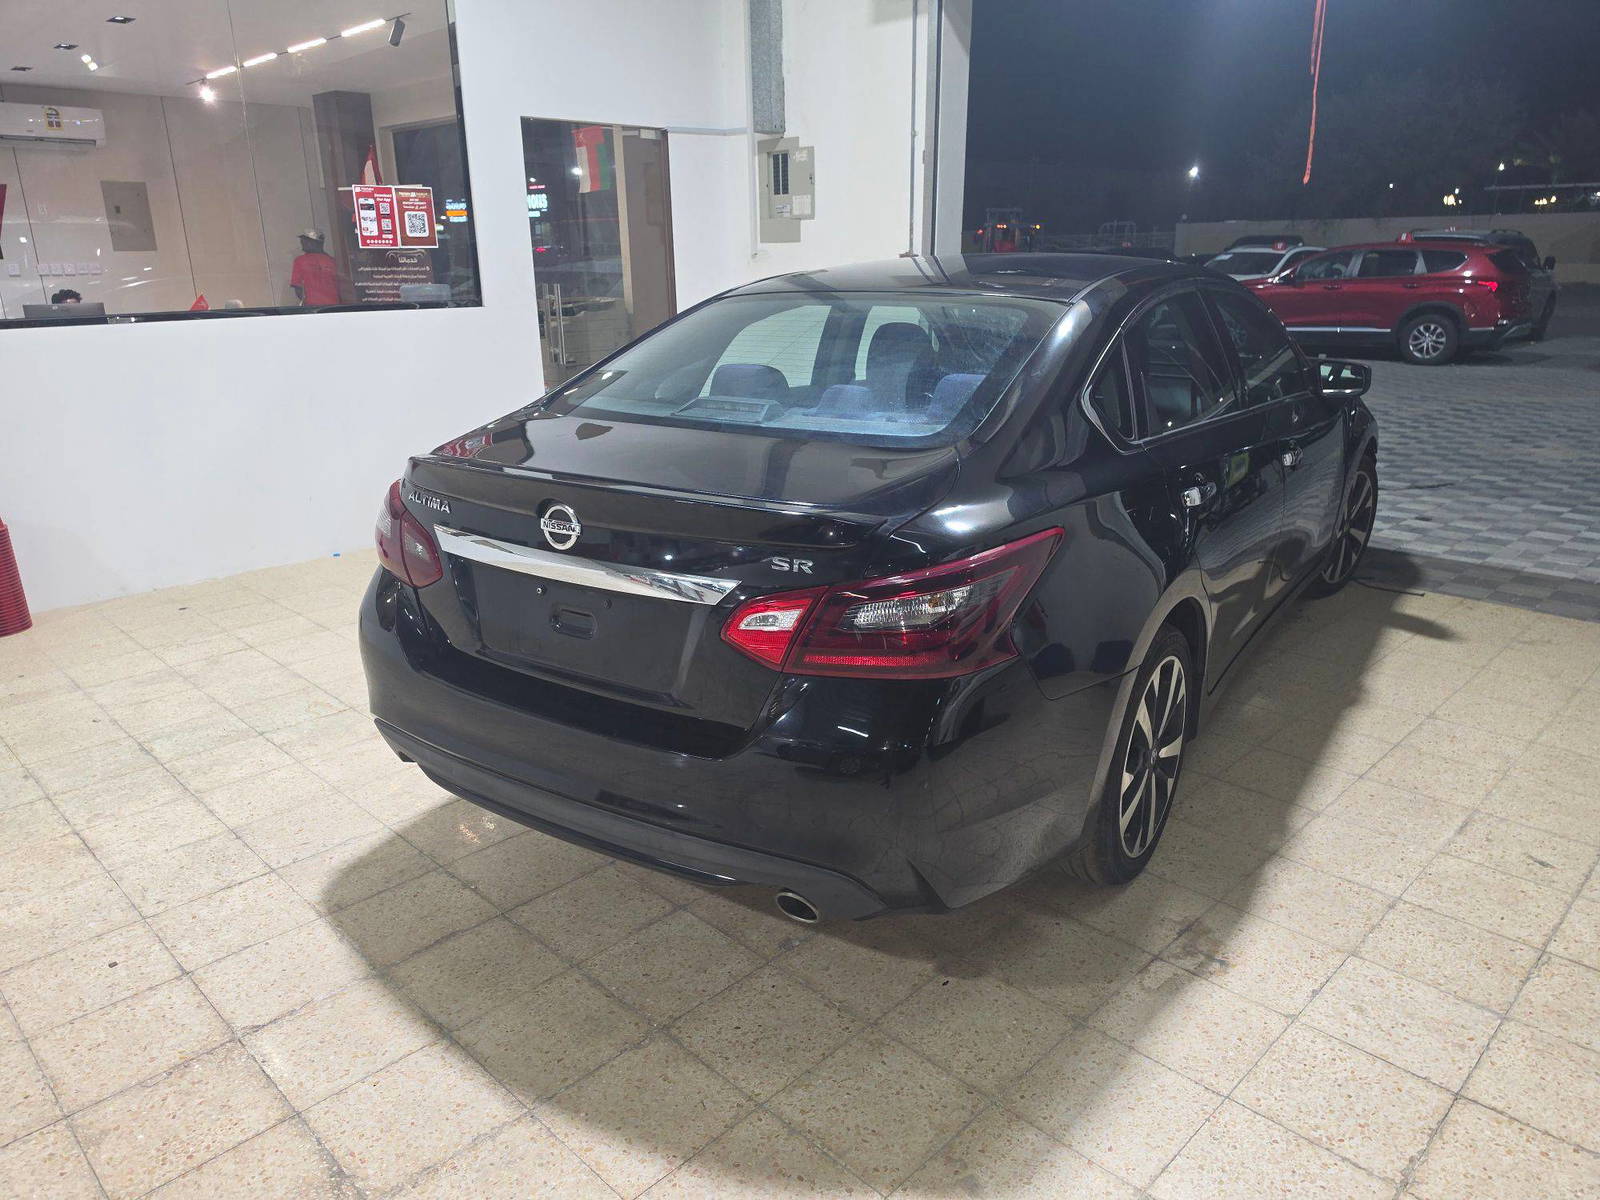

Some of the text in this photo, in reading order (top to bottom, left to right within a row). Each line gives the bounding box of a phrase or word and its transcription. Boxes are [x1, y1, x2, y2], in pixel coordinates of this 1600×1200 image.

[408, 491, 450, 514] ALTIMA
[542, 519, 576, 532] NISSAN
[771, 556, 813, 574] SR
